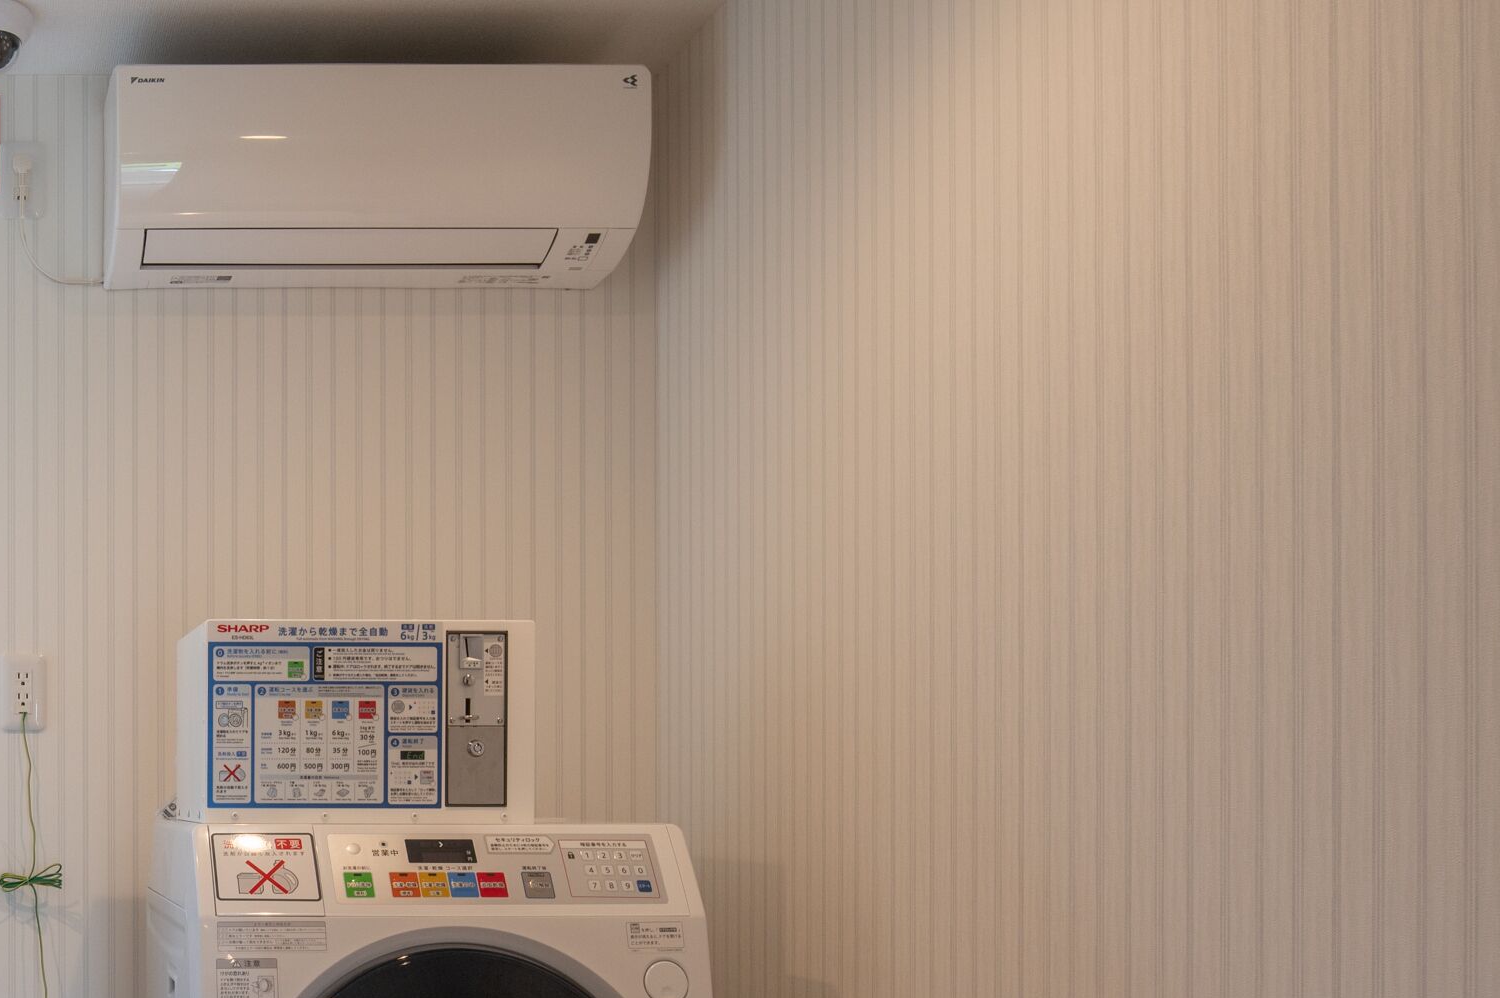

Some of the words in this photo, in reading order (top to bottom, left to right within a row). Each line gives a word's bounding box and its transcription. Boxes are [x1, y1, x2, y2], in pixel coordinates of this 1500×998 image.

[217, 624, 270, 633] SHARP
[277, 626, 389, 637] 洗濯から乾燥まで全自動
[276, 839, 300, 849] 不要
[371, 849, 399, 857] 営業中
